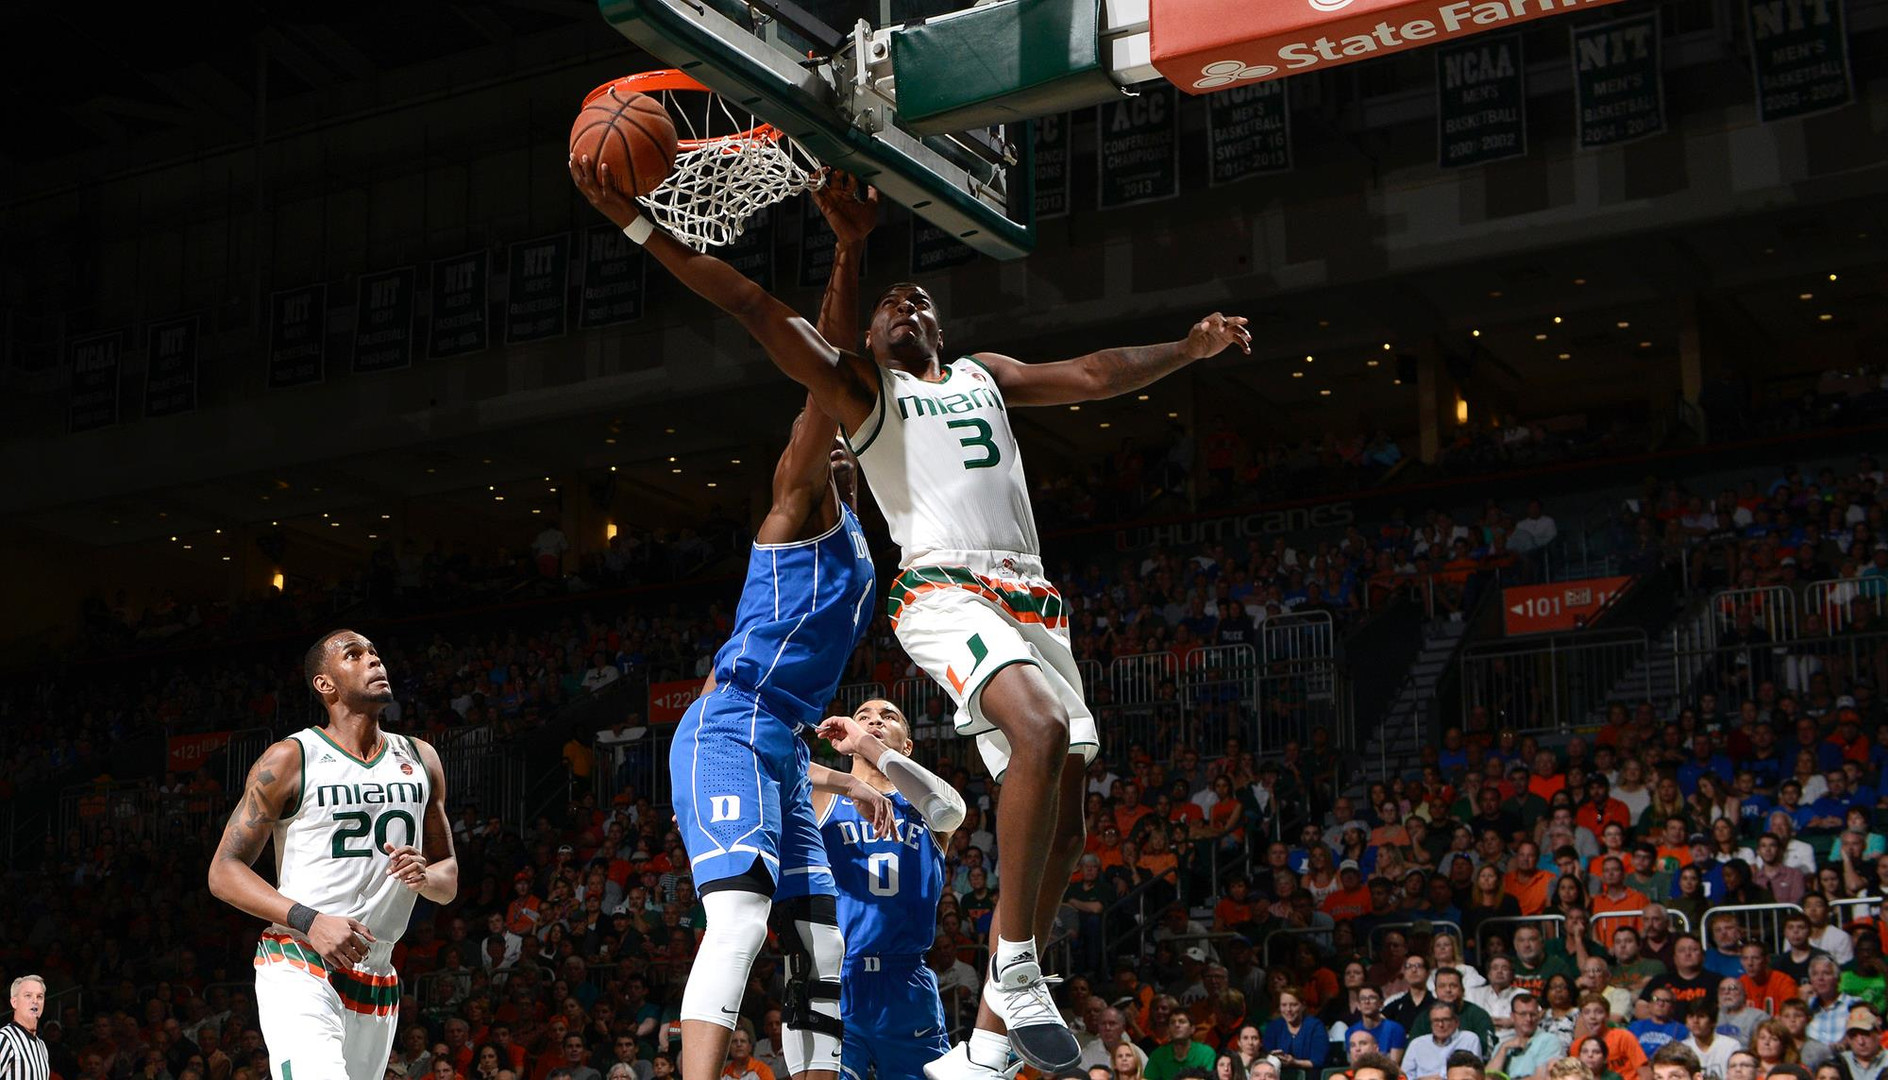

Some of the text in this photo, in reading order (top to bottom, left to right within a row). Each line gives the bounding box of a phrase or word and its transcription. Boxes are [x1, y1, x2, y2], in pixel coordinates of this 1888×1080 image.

[1753, 0, 1830, 39] NIT
[1277, 19, 1437, 69] State
[1578, 25, 1651, 71] NIT
[1444, 43, 1514, 89] NCAA
[1112, 92, 1164, 132] ACC
[1446, 107, 1519, 133] BASKETBALL
[1214, 114, 1283, 142] BASKETBALL
[1269, 132, 1284, 148] 16
[1123, 180, 1153, 198] 2013
[946, 417, 1001, 470] 3
[1525, 596, 1561, 618] 101
[664, 691, 692, 709] 122
[181, 744, 201, 760] 121
[709, 795, 741, 823] D
[331, 809, 416, 859] 20
[838, 819, 925, 850] DUKE
[867, 852, 900, 897] 0
